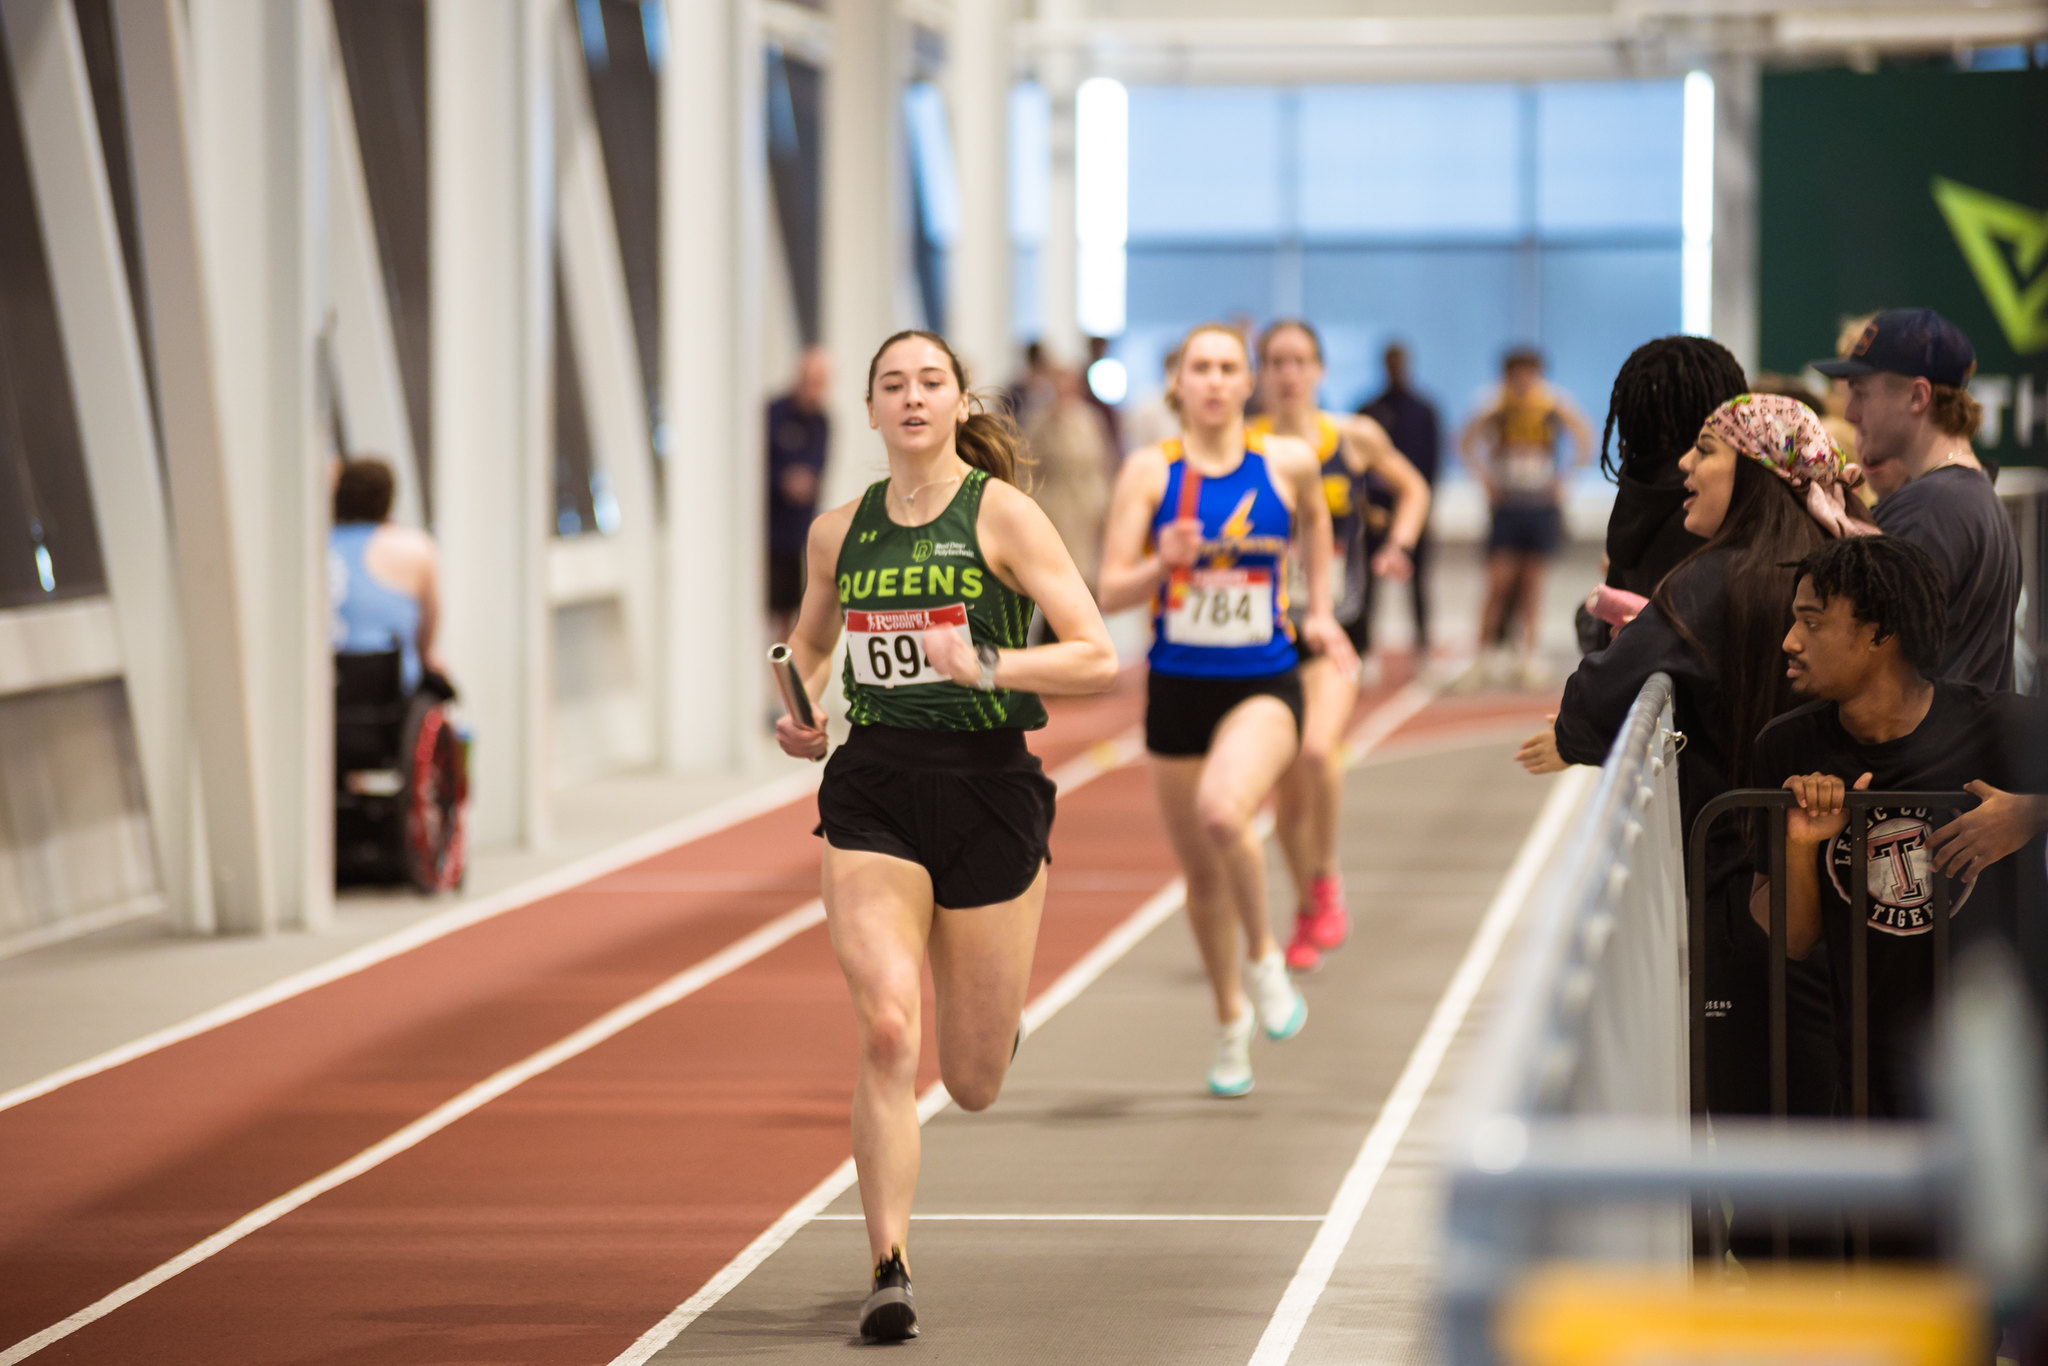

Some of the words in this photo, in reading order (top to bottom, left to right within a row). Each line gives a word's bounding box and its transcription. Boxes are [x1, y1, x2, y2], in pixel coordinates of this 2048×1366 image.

[838, 564, 984, 603] QUEENS
[875, 611, 923, 630] Running
[1192, 588, 1252, 626] 784
[867, 634, 932, 680] 69
[1871, 901, 1934, 928] TIGE
